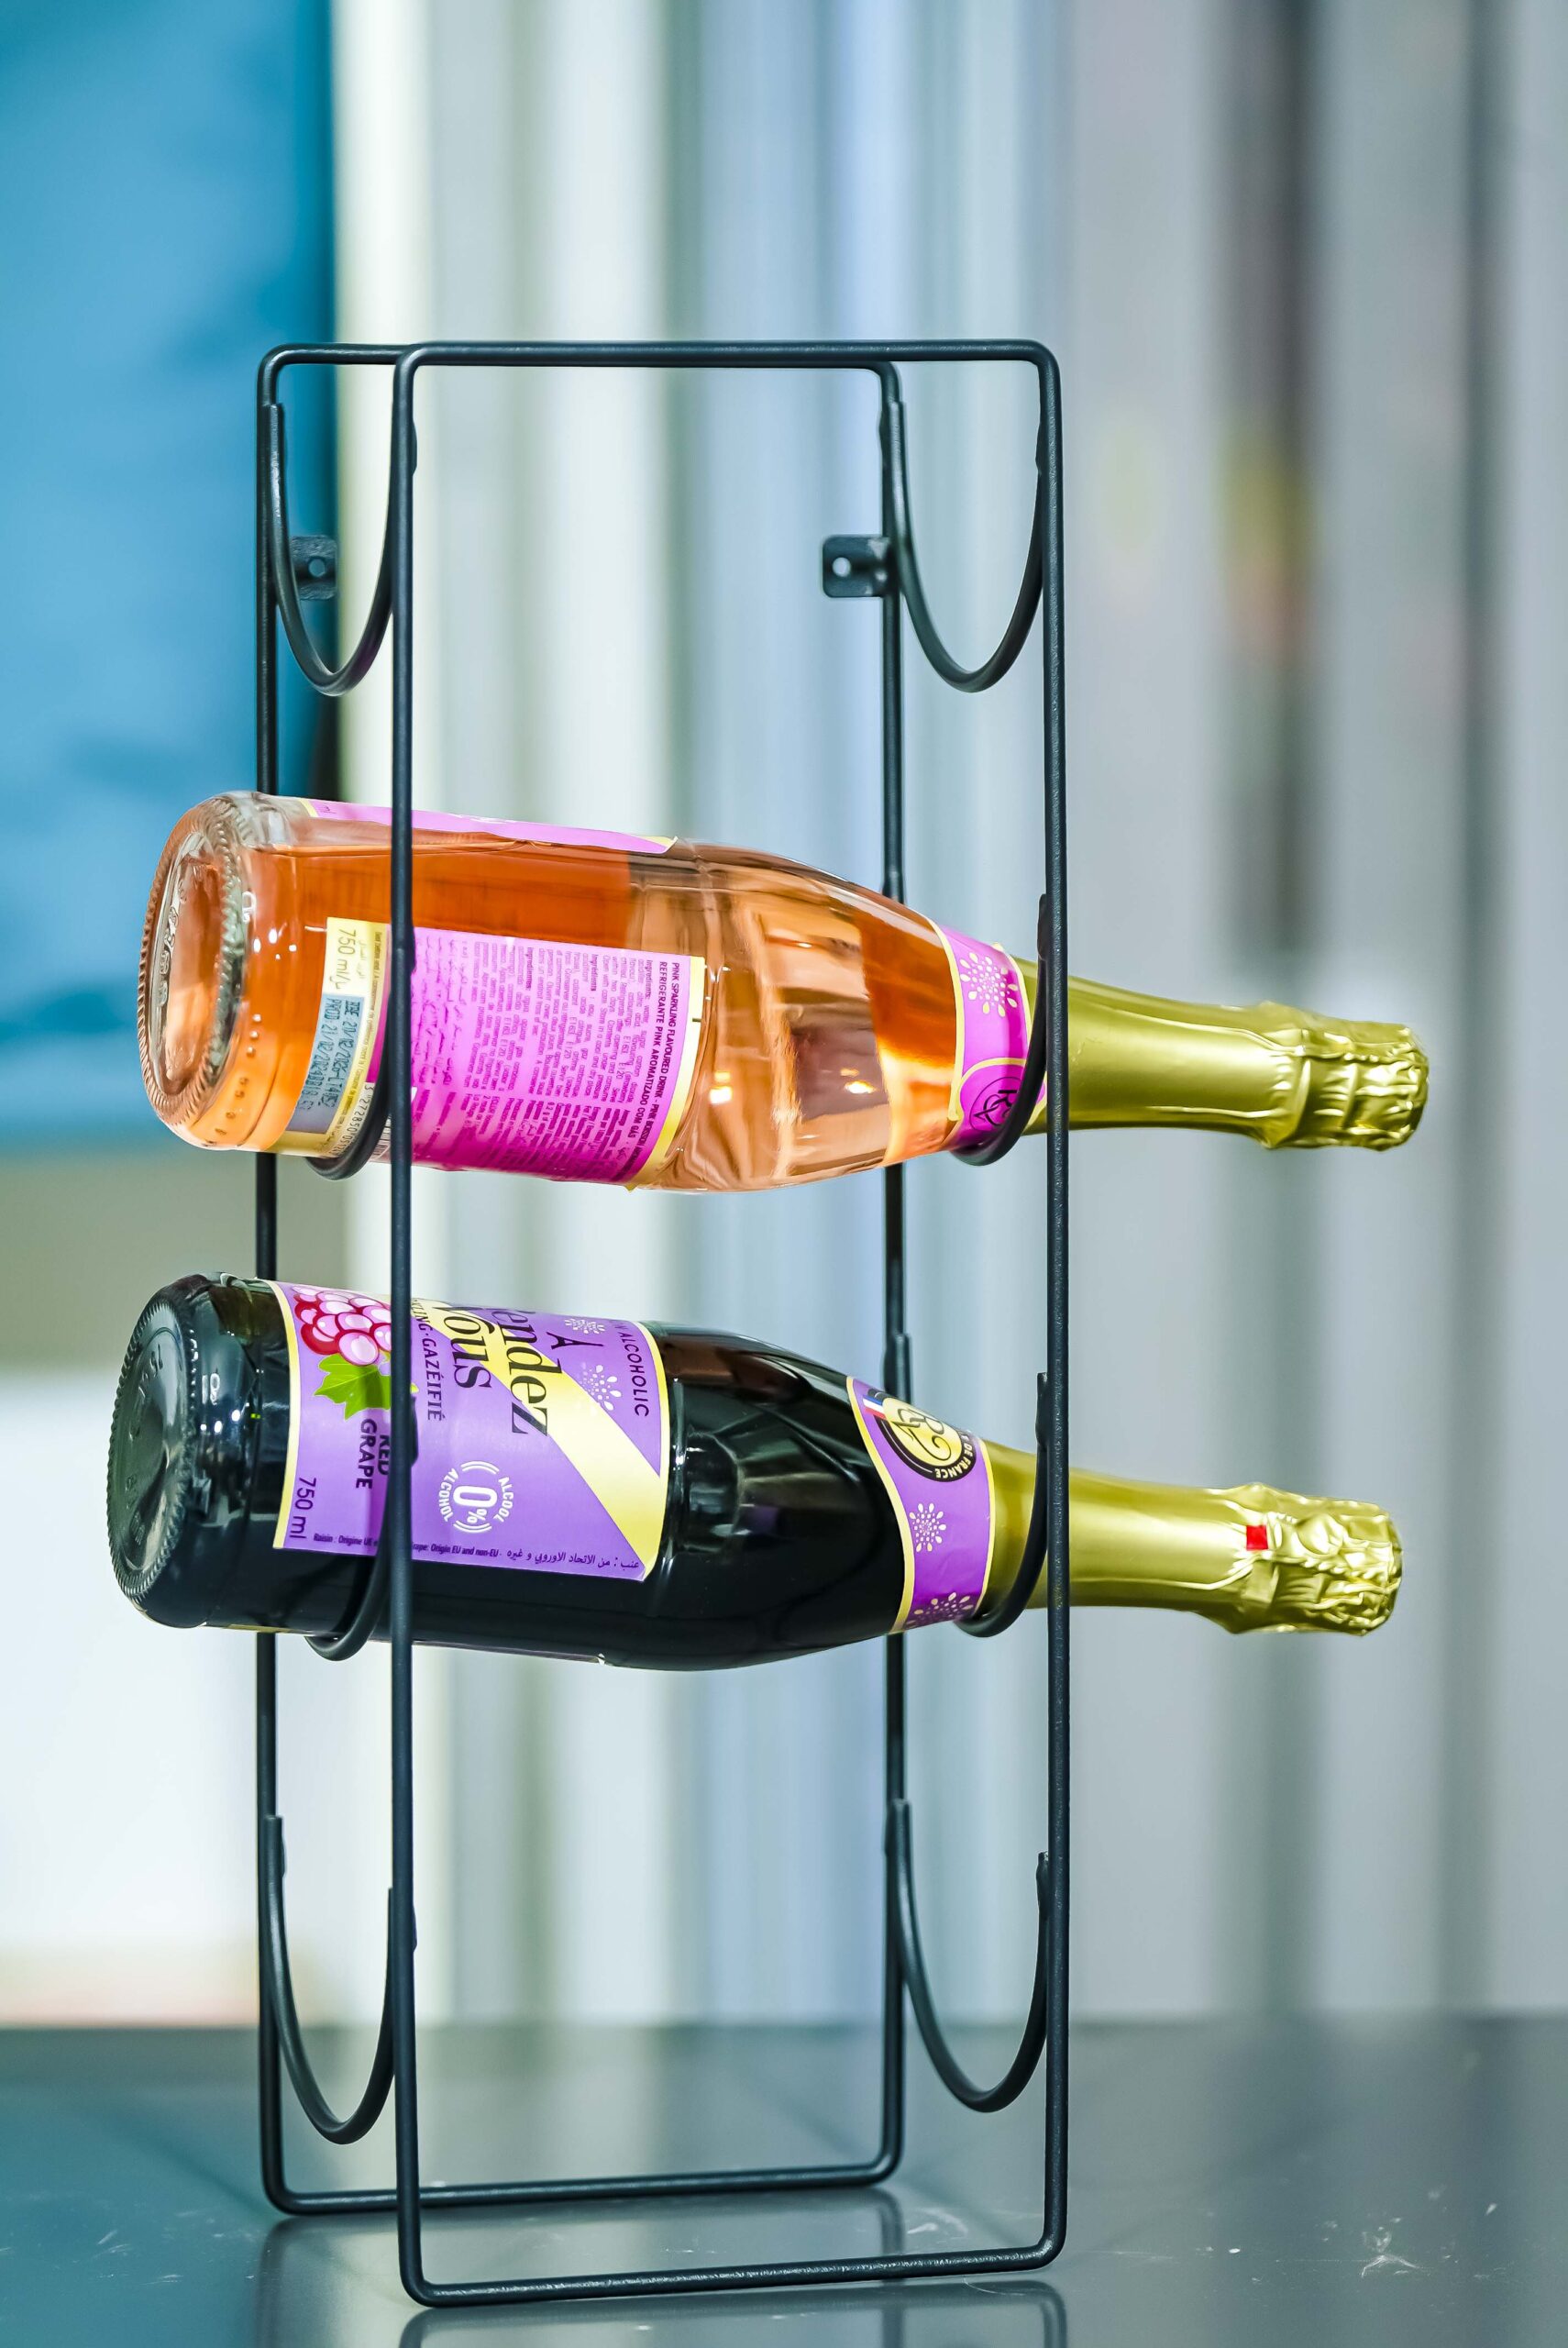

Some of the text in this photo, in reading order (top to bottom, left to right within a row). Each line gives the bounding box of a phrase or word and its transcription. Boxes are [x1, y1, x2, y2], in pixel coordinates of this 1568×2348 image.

[337, 929, 356, 955] 750
[668, 983, 679, 1027] SPARKLING
[627, 961, 667, 1137] REFRIGERANTE PINK AROMATIZADO COM GÁS
[661, 1029, 675, 1073] FLAVOURED
[655, 1076, 667, 1098] DRINK
[422, 1337, 446, 1421] GAZÉIFIÉ
[491, 1310, 562, 1436] endez
[617, 1332, 649, 1417] ALCOHOLIC
[356, 1418, 378, 1490] GRAPE
[934, 1456, 972, 1479] FRANCE
[964, 1442, 973, 1456] DE
[289, 1478, 316, 1539] 750 ml
[438, 1468, 458, 1523] ALCOHOL
[452, 1485, 498, 1523] 0%
[492, 1476, 514, 1523] ALCOOL
[313, 1534, 333, 1543] Raisin
[337, 1534, 362, 1546] Origine
[412, 1542, 499, 1557] rape: Origin EU and non-EU
[525, 1553, 532, 1561] و
[568, 1553, 595, 1565] الاتحاد
[597, 1560, 611, 1568] من
[620, 1560, 639, 1571] عنب
